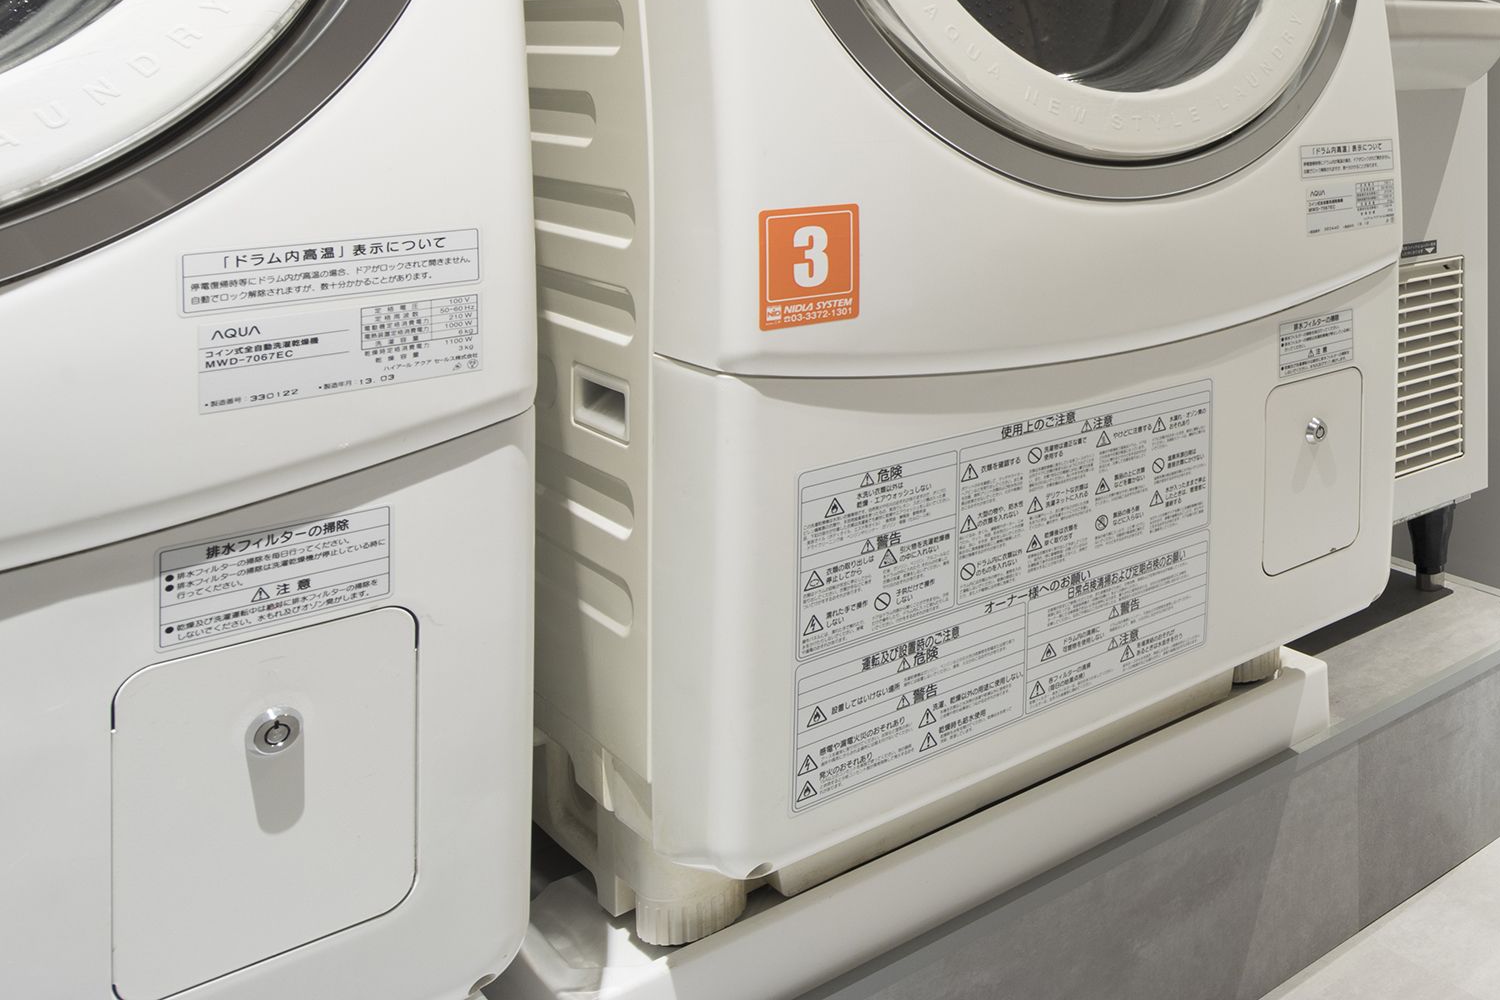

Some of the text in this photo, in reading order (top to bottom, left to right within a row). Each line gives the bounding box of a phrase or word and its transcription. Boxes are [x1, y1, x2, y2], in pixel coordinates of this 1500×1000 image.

[221, 235, 447, 270] 「ドラム内高温」表示について
[793, 225, 829, 288] 3
[815, 298, 853, 311] SYSTEM
[211, 324, 261, 341] AQUA
[205, 336, 320, 360] コイン式全自動洗濯乾燥機
[205, 348, 294, 370] MWD-7067EC
[249, 387, 299, 402] 330122
[1000, 411, 1076, 439] 使用上のご注意
[1092, 415, 1113, 431] 注意
[877, 464, 903, 483] 危険
[206, 518, 350, 560] 排水フィルターの掃除
[876, 531, 901, 550] 警告
[276, 578, 311, 596] 注意
[984, 569, 1091, 615] オーナー様へのお願い
[1119, 628, 1140, 647] 注意
[861, 625, 960, 673] 運転及び設置時のご注意
[912, 646, 940, 667] 危険
[912, 683, 938, 705] 警告
